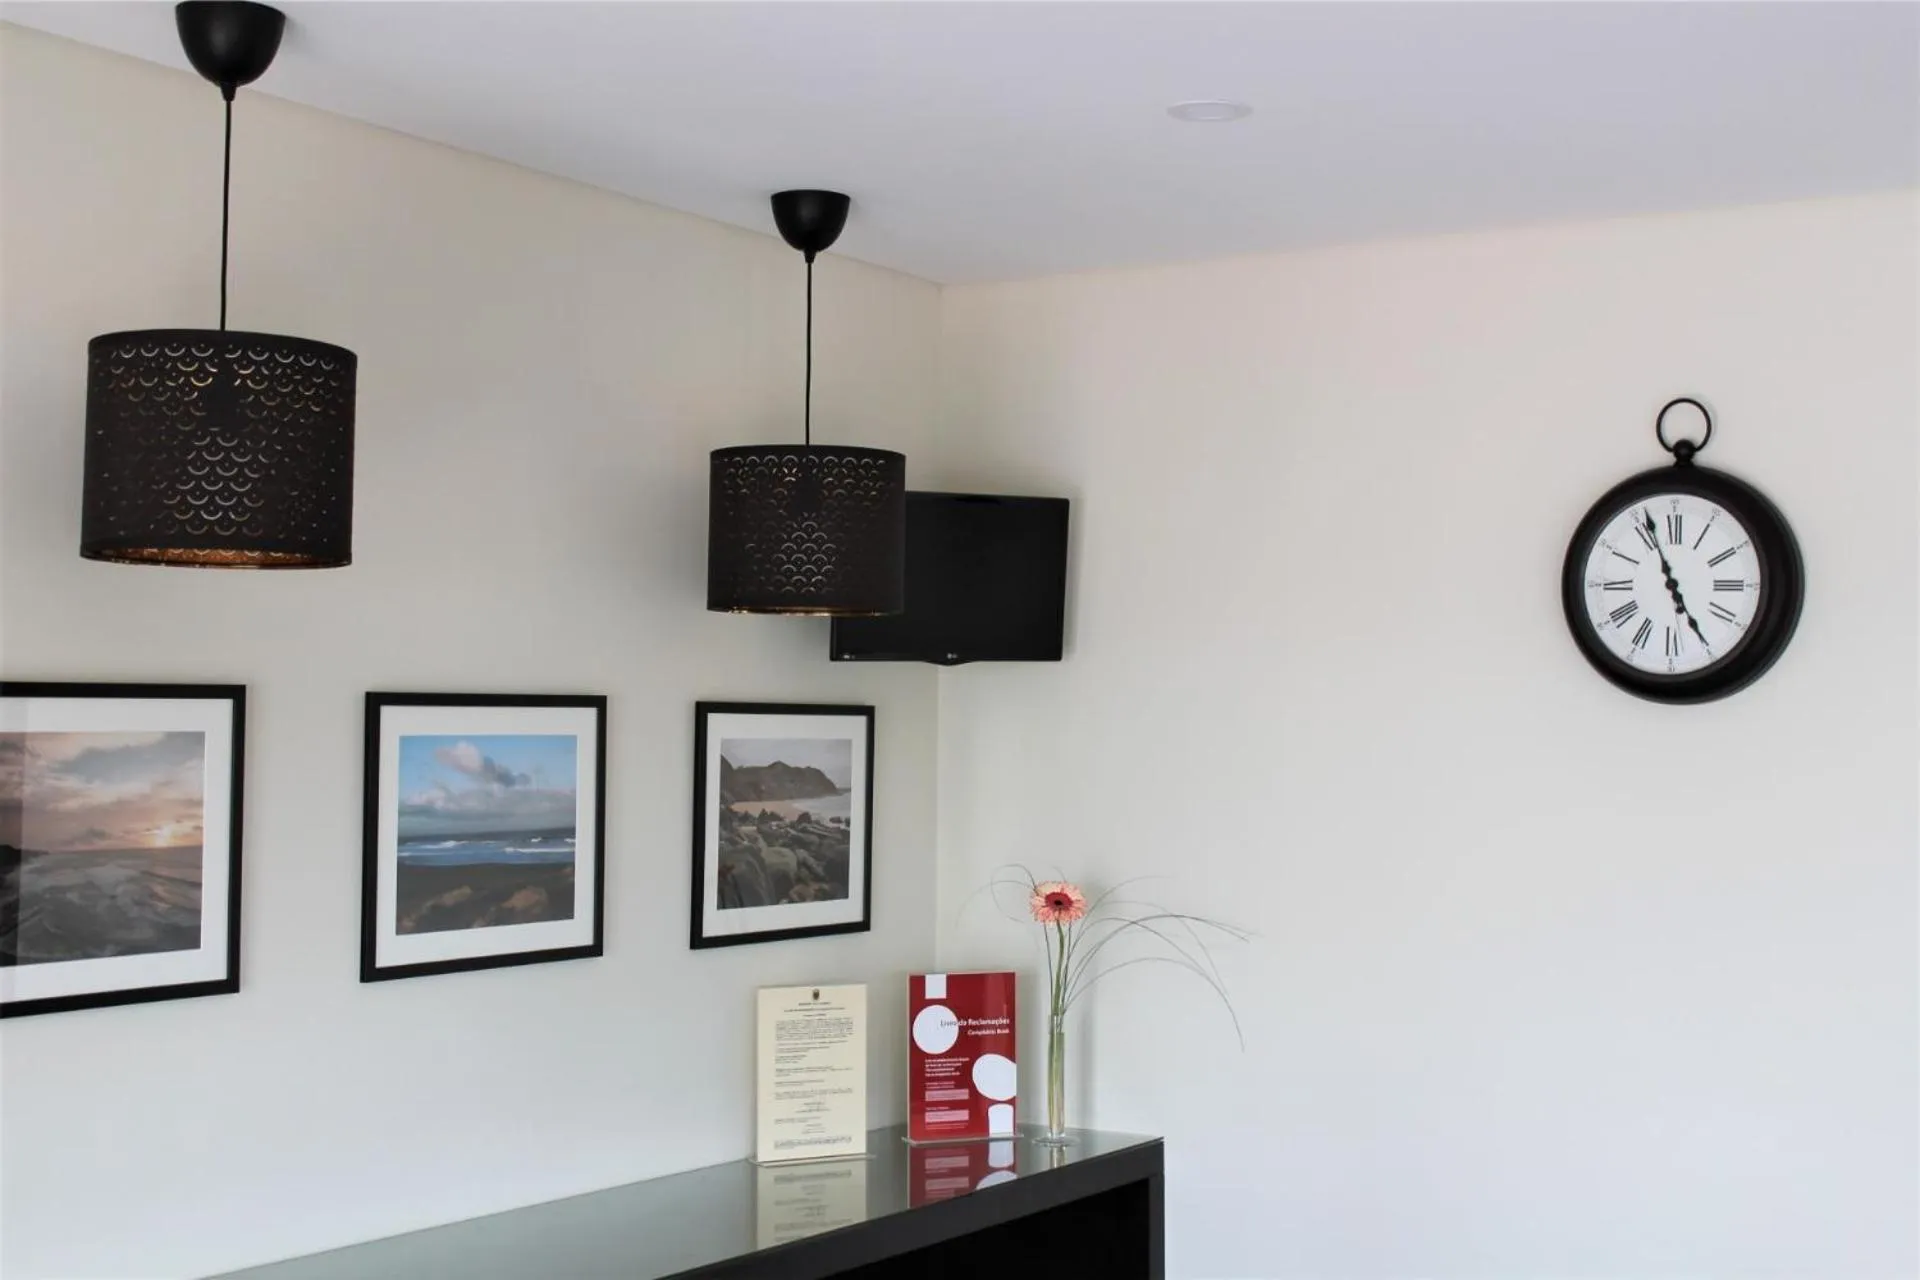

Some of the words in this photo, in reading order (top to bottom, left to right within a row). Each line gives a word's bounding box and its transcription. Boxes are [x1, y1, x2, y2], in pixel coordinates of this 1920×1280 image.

[1693, 523, 1711, 550] I
[1706, 546, 1738, 568] II
[1712, 578, 1745, 592] III
